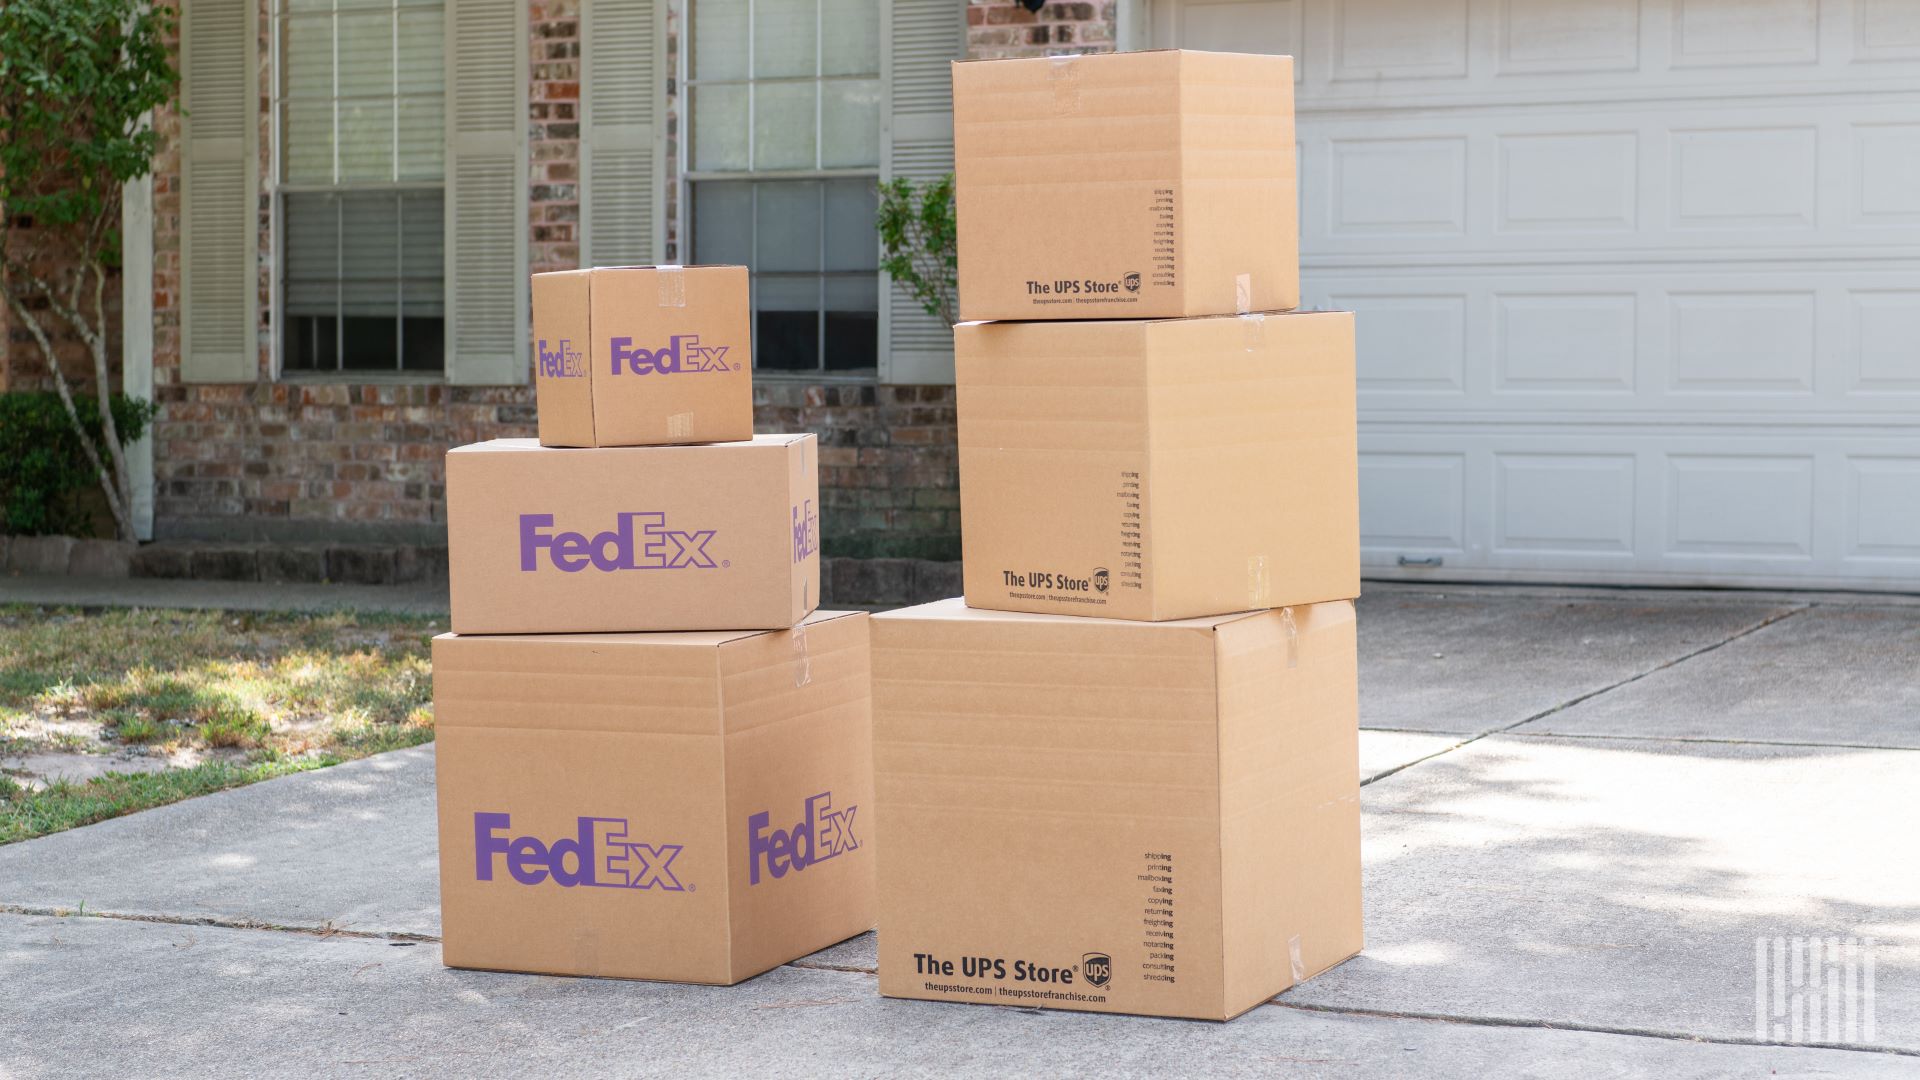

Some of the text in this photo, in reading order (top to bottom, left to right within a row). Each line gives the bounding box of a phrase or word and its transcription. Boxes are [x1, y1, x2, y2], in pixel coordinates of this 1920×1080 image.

[1026, 281, 1049, 294] The
[1055, 280, 1080, 293] UPS
[1085, 280, 1118, 292] Store
[539, 339, 582, 378] FedEx
[611, 335, 729, 375] FedEx
[793, 499, 818, 564] FedEx
[520, 512, 718, 572] FedEx
[1003, 571, 1025, 586] The
[1029, 573, 1052, 589] UPS
[1057, 574, 1088, 591] Store
[1010, 591, 1106, 604] theupsstore.com theupsstorefranchise.com
[748, 791, 858, 885] FedEx
[474, 812, 685, 891] FedEx
[1145, 852, 1171, 861] shipping
[1148, 864, 1172, 872] printing
[1138, 874, 1172, 883] mailboxing
[1153, 886, 1172, 894] faxing
[1148, 897, 1172, 906] copying
[1145, 908, 1173, 916] returning
[1144, 918, 1173, 927] freighting
[1146, 930, 1173, 938] receiving
[1144, 940, 1174, 949] notarizing
[1150, 952, 1174, 960] packing
[914, 953, 1109, 984] The UPS Store ups
[1143, 962, 1174, 971] consulting
[1144, 973, 1175, 983] shredding
[925, 981, 1106, 1003] theupsstore.com theupsstorefranchise.com
